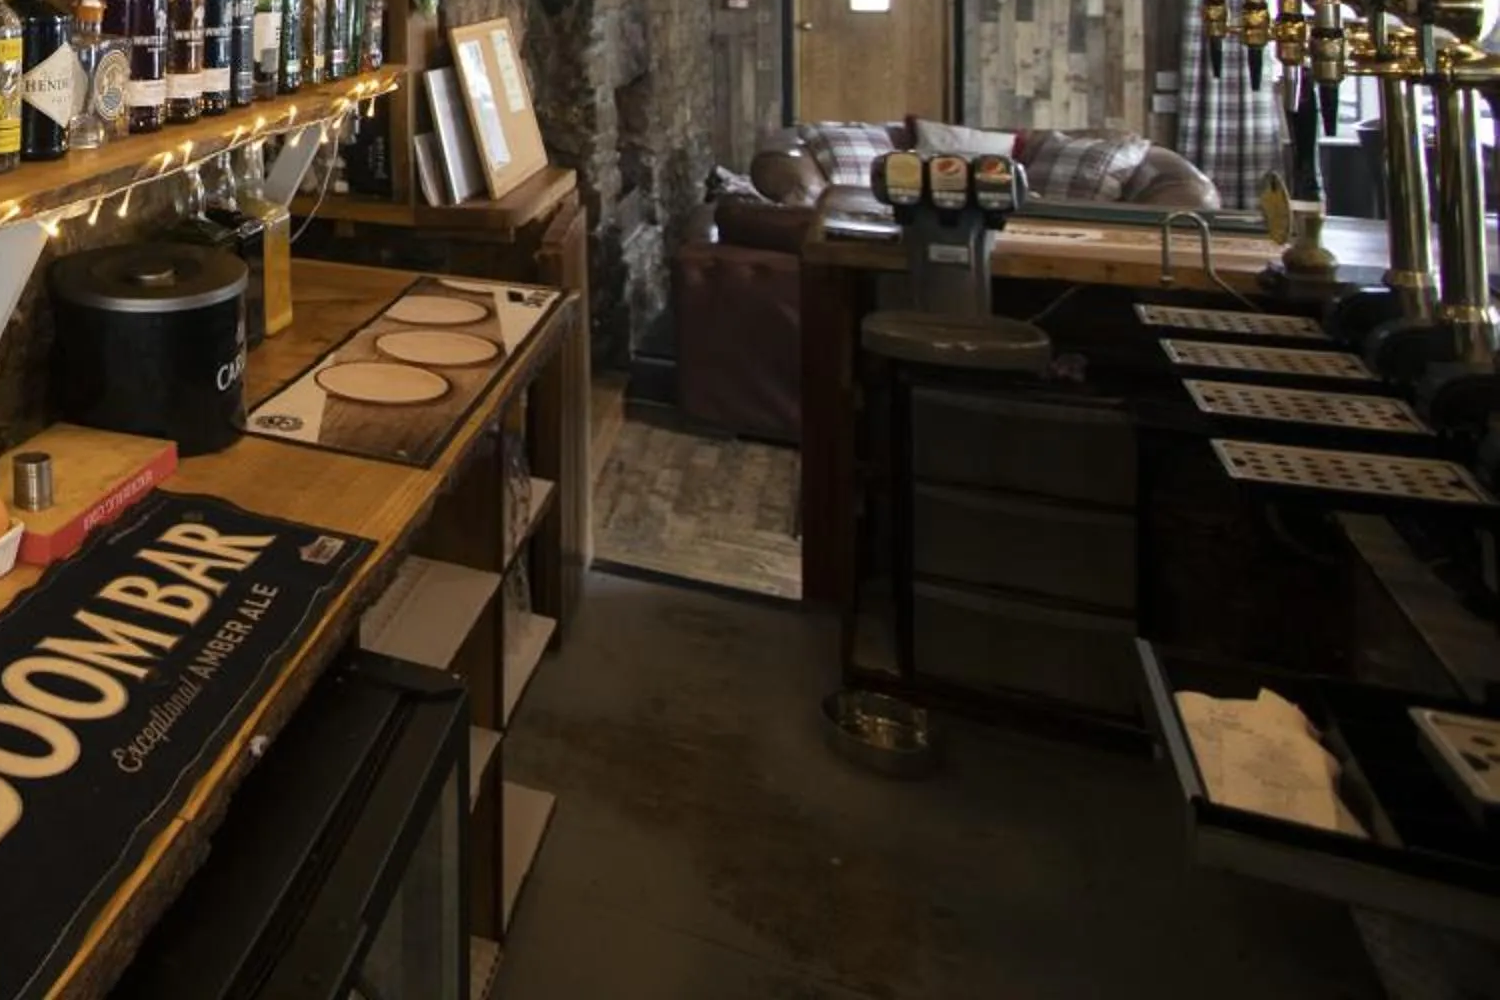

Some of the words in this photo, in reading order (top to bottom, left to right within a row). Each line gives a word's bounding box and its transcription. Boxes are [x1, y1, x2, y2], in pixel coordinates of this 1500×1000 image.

[97, 521, 277, 628] BAR
[111, 674, 203, 774] Exceptional
[188, 619, 253, 680] AMBER
[238, 582, 280, 622] ALE
